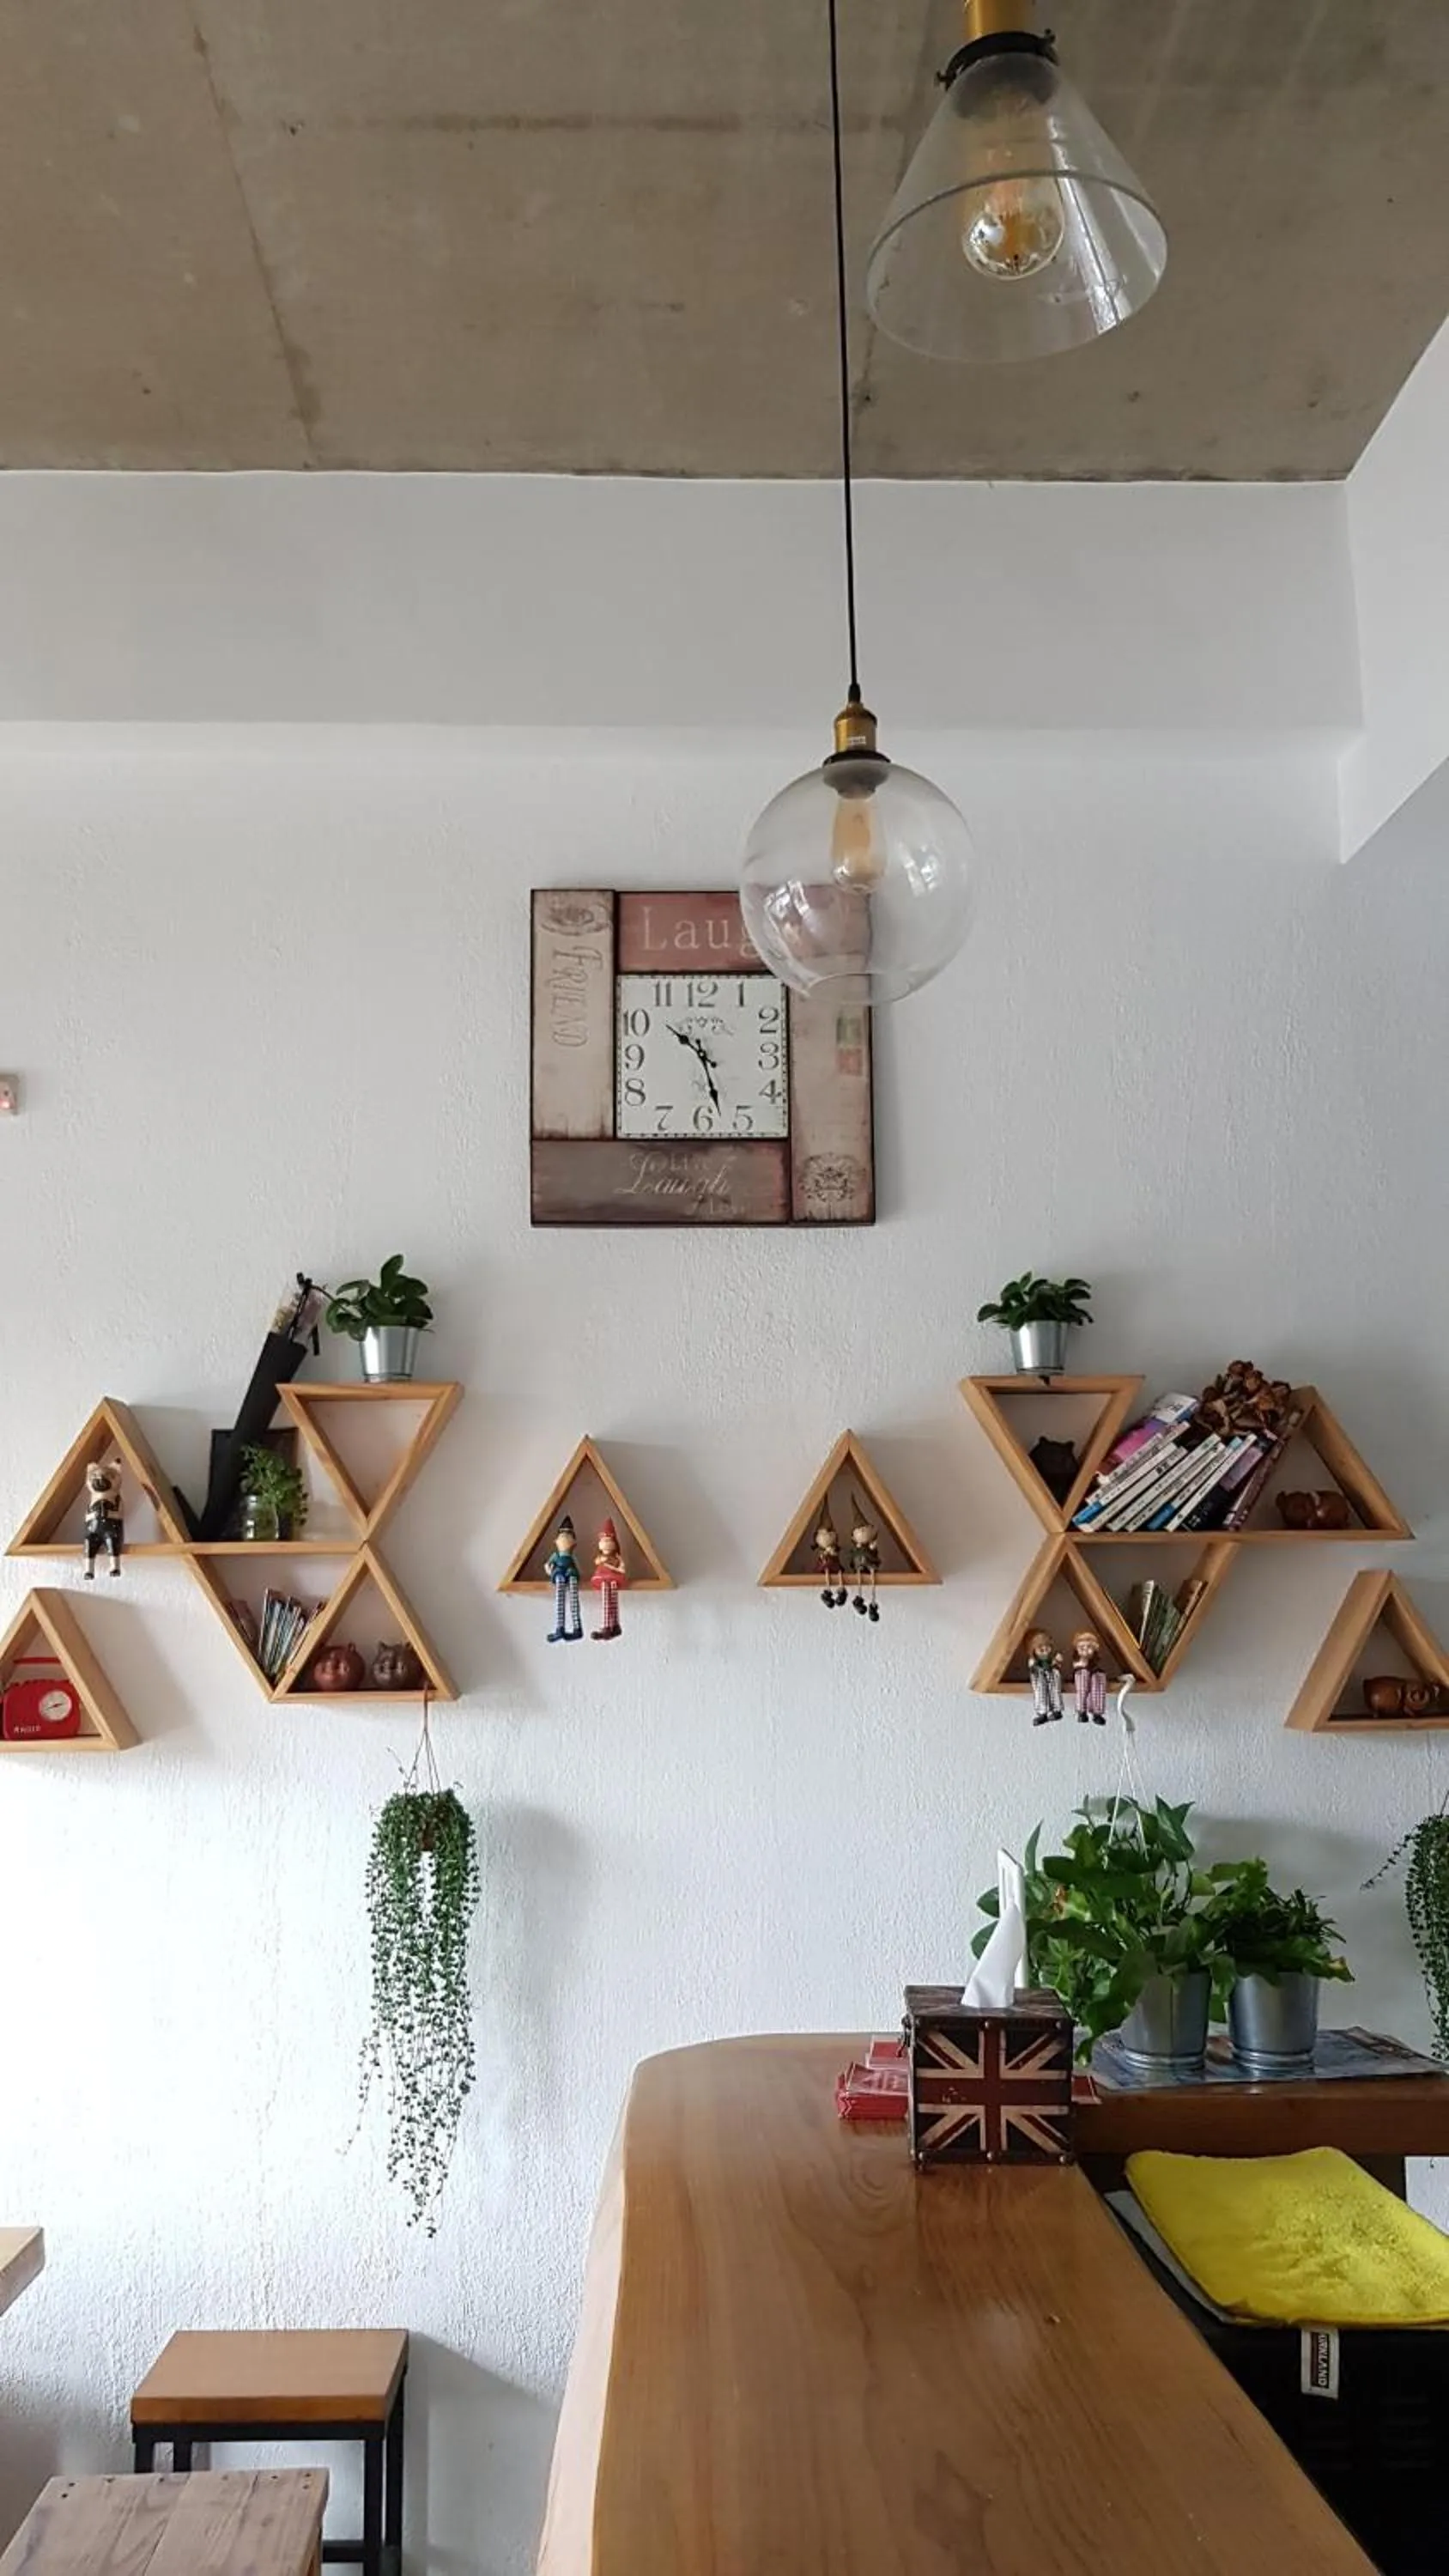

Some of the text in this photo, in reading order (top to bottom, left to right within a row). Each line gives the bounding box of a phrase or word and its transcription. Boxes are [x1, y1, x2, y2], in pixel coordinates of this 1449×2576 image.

[641, 907, 760, 959] Laug
[546, 945, 603, 1048] FRIEND
[654, 981, 672, 1007] 11
[688, 981, 718, 1008] 12
[737, 981, 744, 1007] 1
[622, 1008, 650, 1036] 10
[758, 1005, 779, 1034] 2
[624, 1043, 645, 1072] 9
[758, 1041, 779, 1071] 3
[624, 1078, 646, 1107] 8
[759, 1079, 782, 1105] 4
[655, 1105, 674, 1132] 7
[693, 1104, 714, 1132] 6
[732, 1105, 754, 1132] 5
